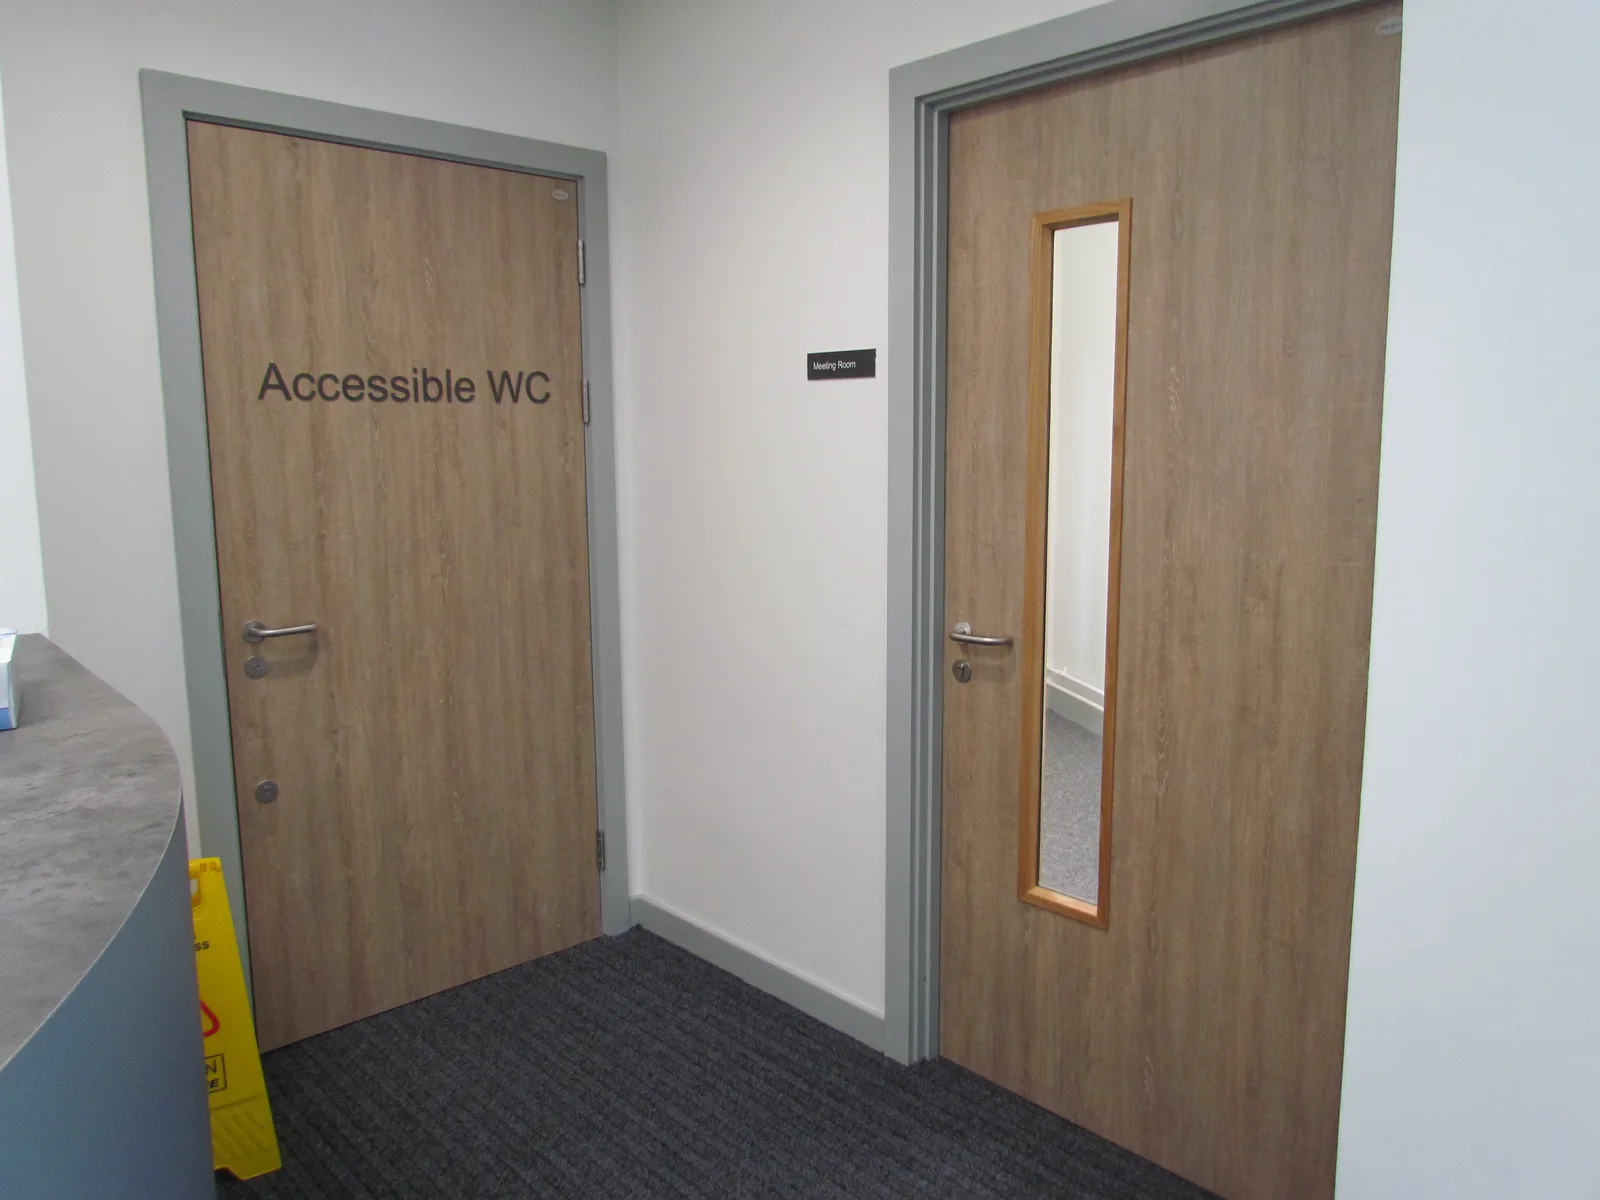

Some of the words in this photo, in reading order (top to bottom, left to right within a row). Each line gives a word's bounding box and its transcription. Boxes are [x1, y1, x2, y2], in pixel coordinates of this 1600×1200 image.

[813, 361, 836, 371] Meeting
[838, 361, 856, 369] Room
[257, 362, 476, 403] Accessible
[487, 369, 551, 404] WC
